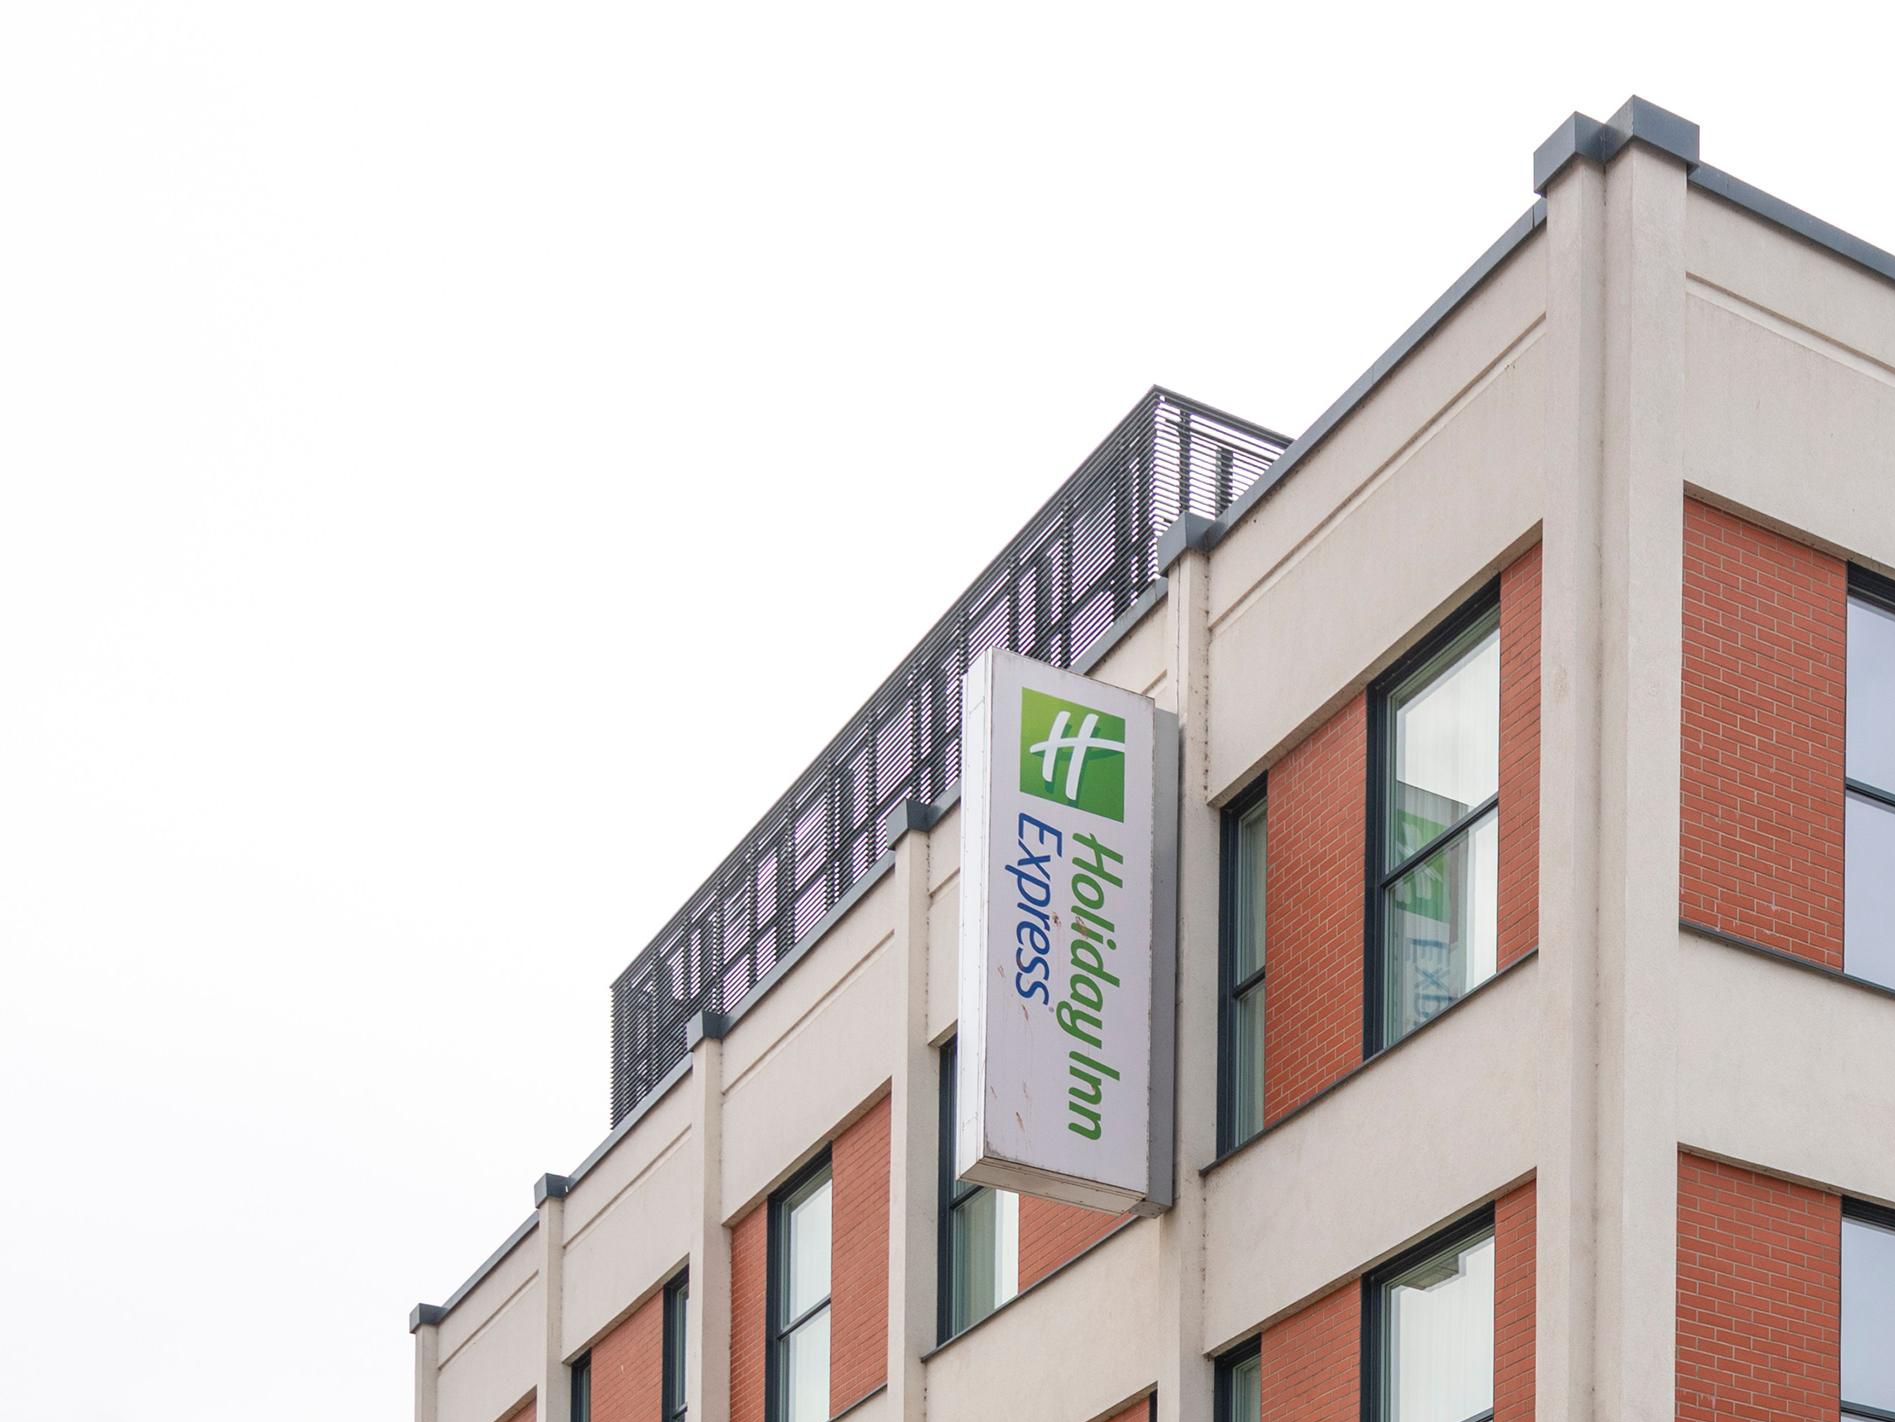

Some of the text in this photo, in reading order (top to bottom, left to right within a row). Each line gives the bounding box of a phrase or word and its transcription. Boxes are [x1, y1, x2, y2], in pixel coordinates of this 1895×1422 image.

[1005, 811, 1063, 1006] Express
[1056, 832, 1123, 1141] Holiday Inn
